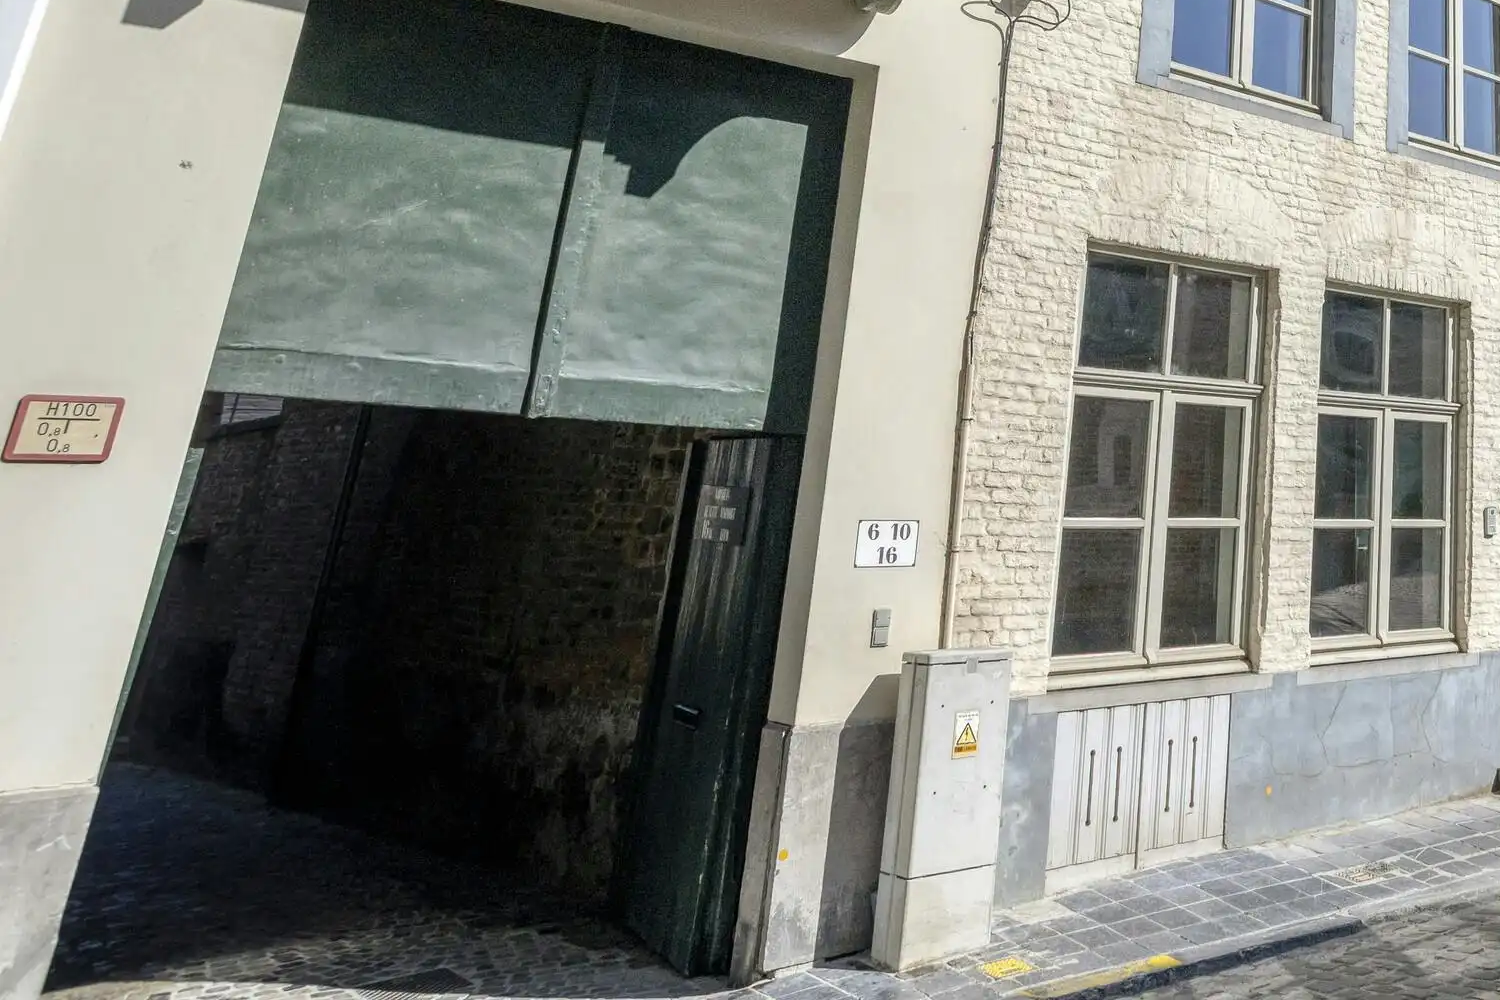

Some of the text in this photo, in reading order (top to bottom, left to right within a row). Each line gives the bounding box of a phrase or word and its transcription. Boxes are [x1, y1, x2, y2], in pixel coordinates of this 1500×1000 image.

[46, 402, 97, 416] H100
[37, 422, 61, 437] 0,8
[47, 438, 70, 453] 0,8
[868, 523, 911, 540] 6 10
[876, 546, 898, 564] 16
